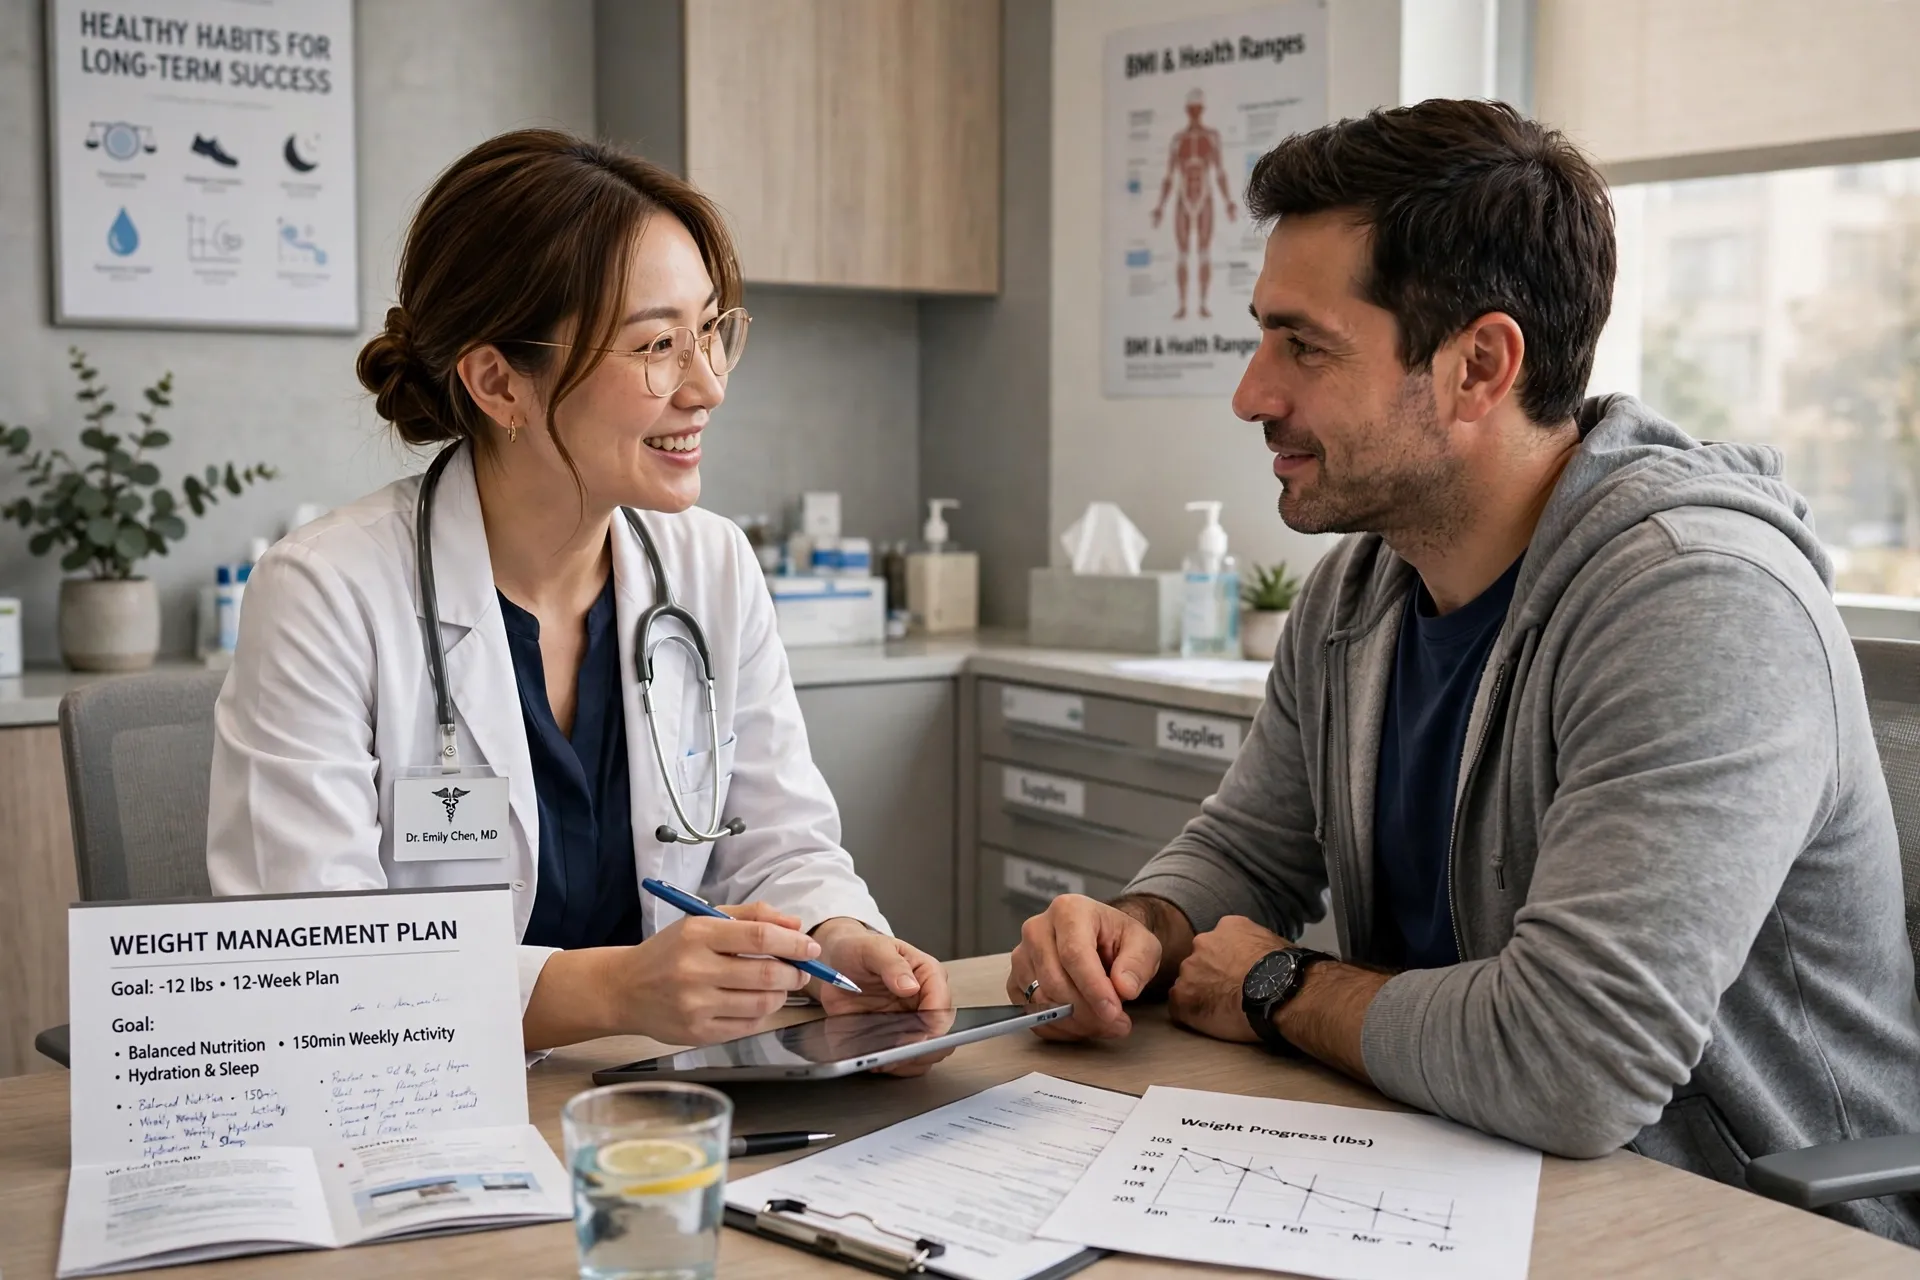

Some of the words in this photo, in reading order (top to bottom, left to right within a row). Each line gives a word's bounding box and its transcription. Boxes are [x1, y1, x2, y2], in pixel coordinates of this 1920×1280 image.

[81, 11, 188, 46] HEALTHY
[197, 22, 280, 56] HABITS
[288, 32, 332, 60] FOR
[81, 47, 222, 84] LONG-TERM
[229, 61, 332, 94] SUCCESS
[1125, 52, 1158, 79] BMI
[1162, 48, 1175, 74] &
[1179, 38, 1235, 69] Health
[1239, 34, 1305, 63] Ranges
[1167, 335, 1208, 354] Health
[1166, 720, 1225, 749] Supplies
[406, 833, 420, 842] Dr.
[422, 831, 448, 844] Emily
[450, 831, 478, 841] Chen,
[480, 830, 498, 839] MD
[110, 931, 208, 955] WEIGHT
[217, 923, 389, 950] MANAGEMENT
[397, 920, 458, 942] PLAN
[111, 979, 153, 996] Goal:
[159, 978, 185, 993] -12
[190, 977, 213, 992] lbs
[233, 972, 301, 990] 12-Week
[306, 970, 339, 985] Plan
[112, 1016, 154, 1033] Goal:
[129, 1042, 195, 1060] Balanced
[200, 1039, 265, 1055] Nutrition
[293, 1033, 345, 1049] 150min
[349, 1029, 399, 1046] Weekly
[403, 1027, 455, 1042] Activity
[129, 1065, 200, 1085] Hydration
[204, 1063, 215, 1077] &
[219, 1061, 259, 1077] Sleep
[1181, 1117, 1244, 1132] Weight
[1249, 1125, 1327, 1141] Progress
[1333, 1135, 1374, 1147] (lbs)
[1144, 1207, 1168, 1216] Jan
[1210, 1216, 1236, 1225] Jan
[1282, 1224, 1308, 1234] Feb
[1352, 1233, 1383, 1244] Mar
[1428, 1242, 1455, 1252] Apr
